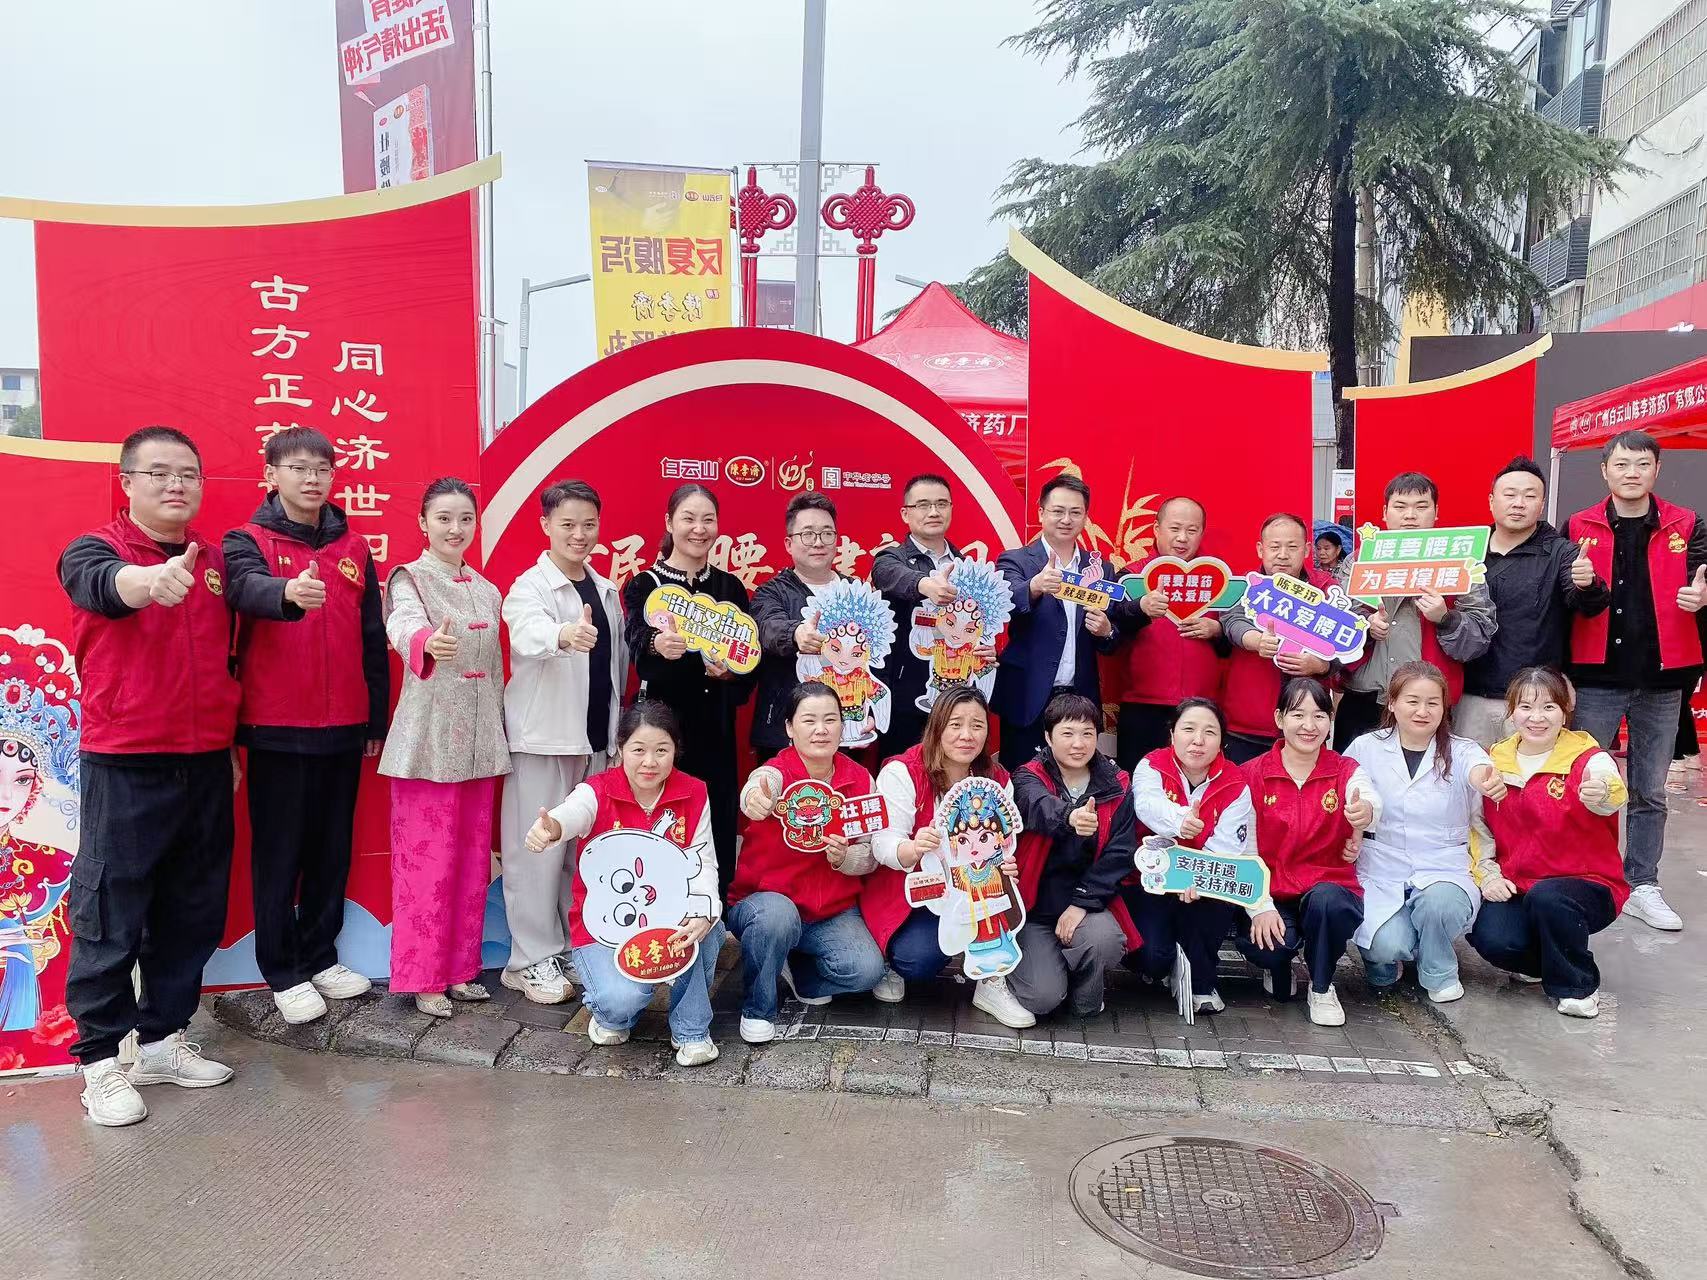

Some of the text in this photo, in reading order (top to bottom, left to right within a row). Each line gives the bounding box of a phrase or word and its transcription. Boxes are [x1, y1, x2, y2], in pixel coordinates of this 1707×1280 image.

[1594, 383, 1707, 430] 广州白云山陈李济药厂有限公
[660, 457, 719, 480] 白云山
[1372, 535, 1475, 560] 腰要腰药
[1359, 566, 1461, 591] 为爱撑腰
[668, 593, 754, 644] 治标又治本
[1252, 588, 1358, 647] 大众爱腰日
[840, 797, 881, 819] 壮腰
[842, 816, 883, 837] 健肾
[1176, 856, 1237, 878] 支持非遗
[1194, 875, 1253, 897] 支持豫剧
